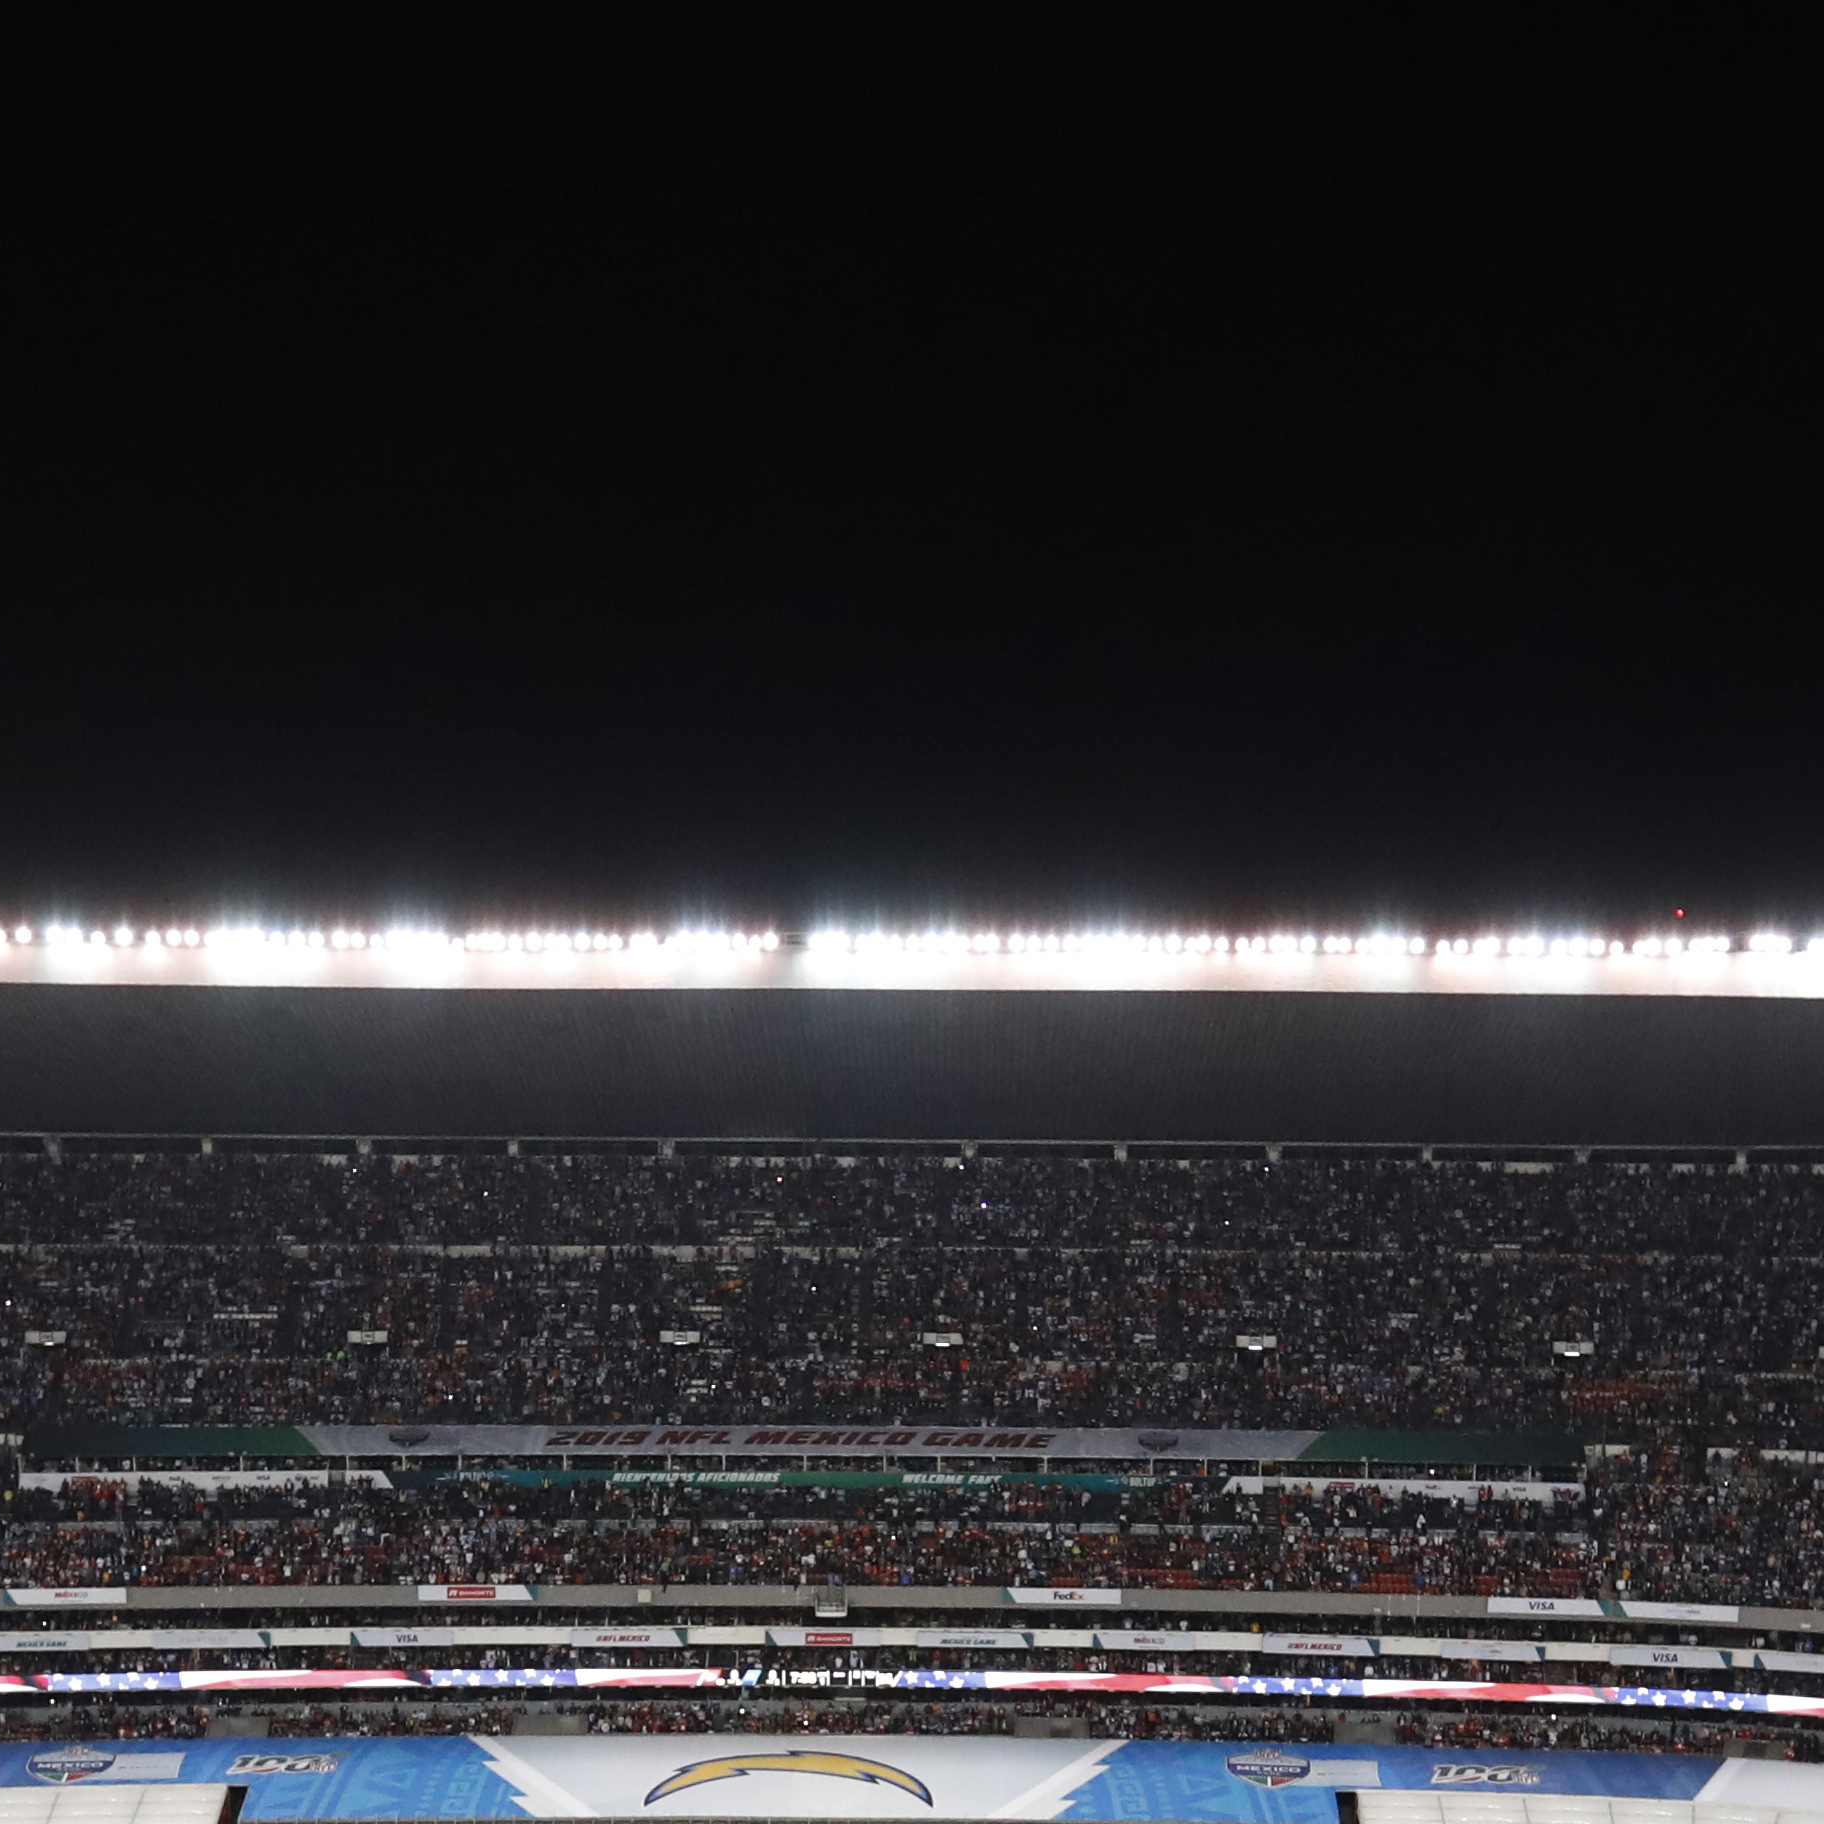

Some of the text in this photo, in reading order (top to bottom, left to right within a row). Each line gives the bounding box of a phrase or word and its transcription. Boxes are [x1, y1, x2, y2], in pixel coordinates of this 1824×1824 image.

[545, 1430, 1057, 1449] 2019 NFL MEXICO GAME
[902, 1473, 965, 1485] WELCOME
[1053, 1590, 1085, 1601] FedEx
[1528, 1600, 1555, 1612] VISA
[395, 1632, 419, 1643] VISA
[1652, 1652, 1679, 1664] VISA
[37, 1760, 105, 1769] MEXICO
[1236, 1764, 1302, 1774] MEXICO
